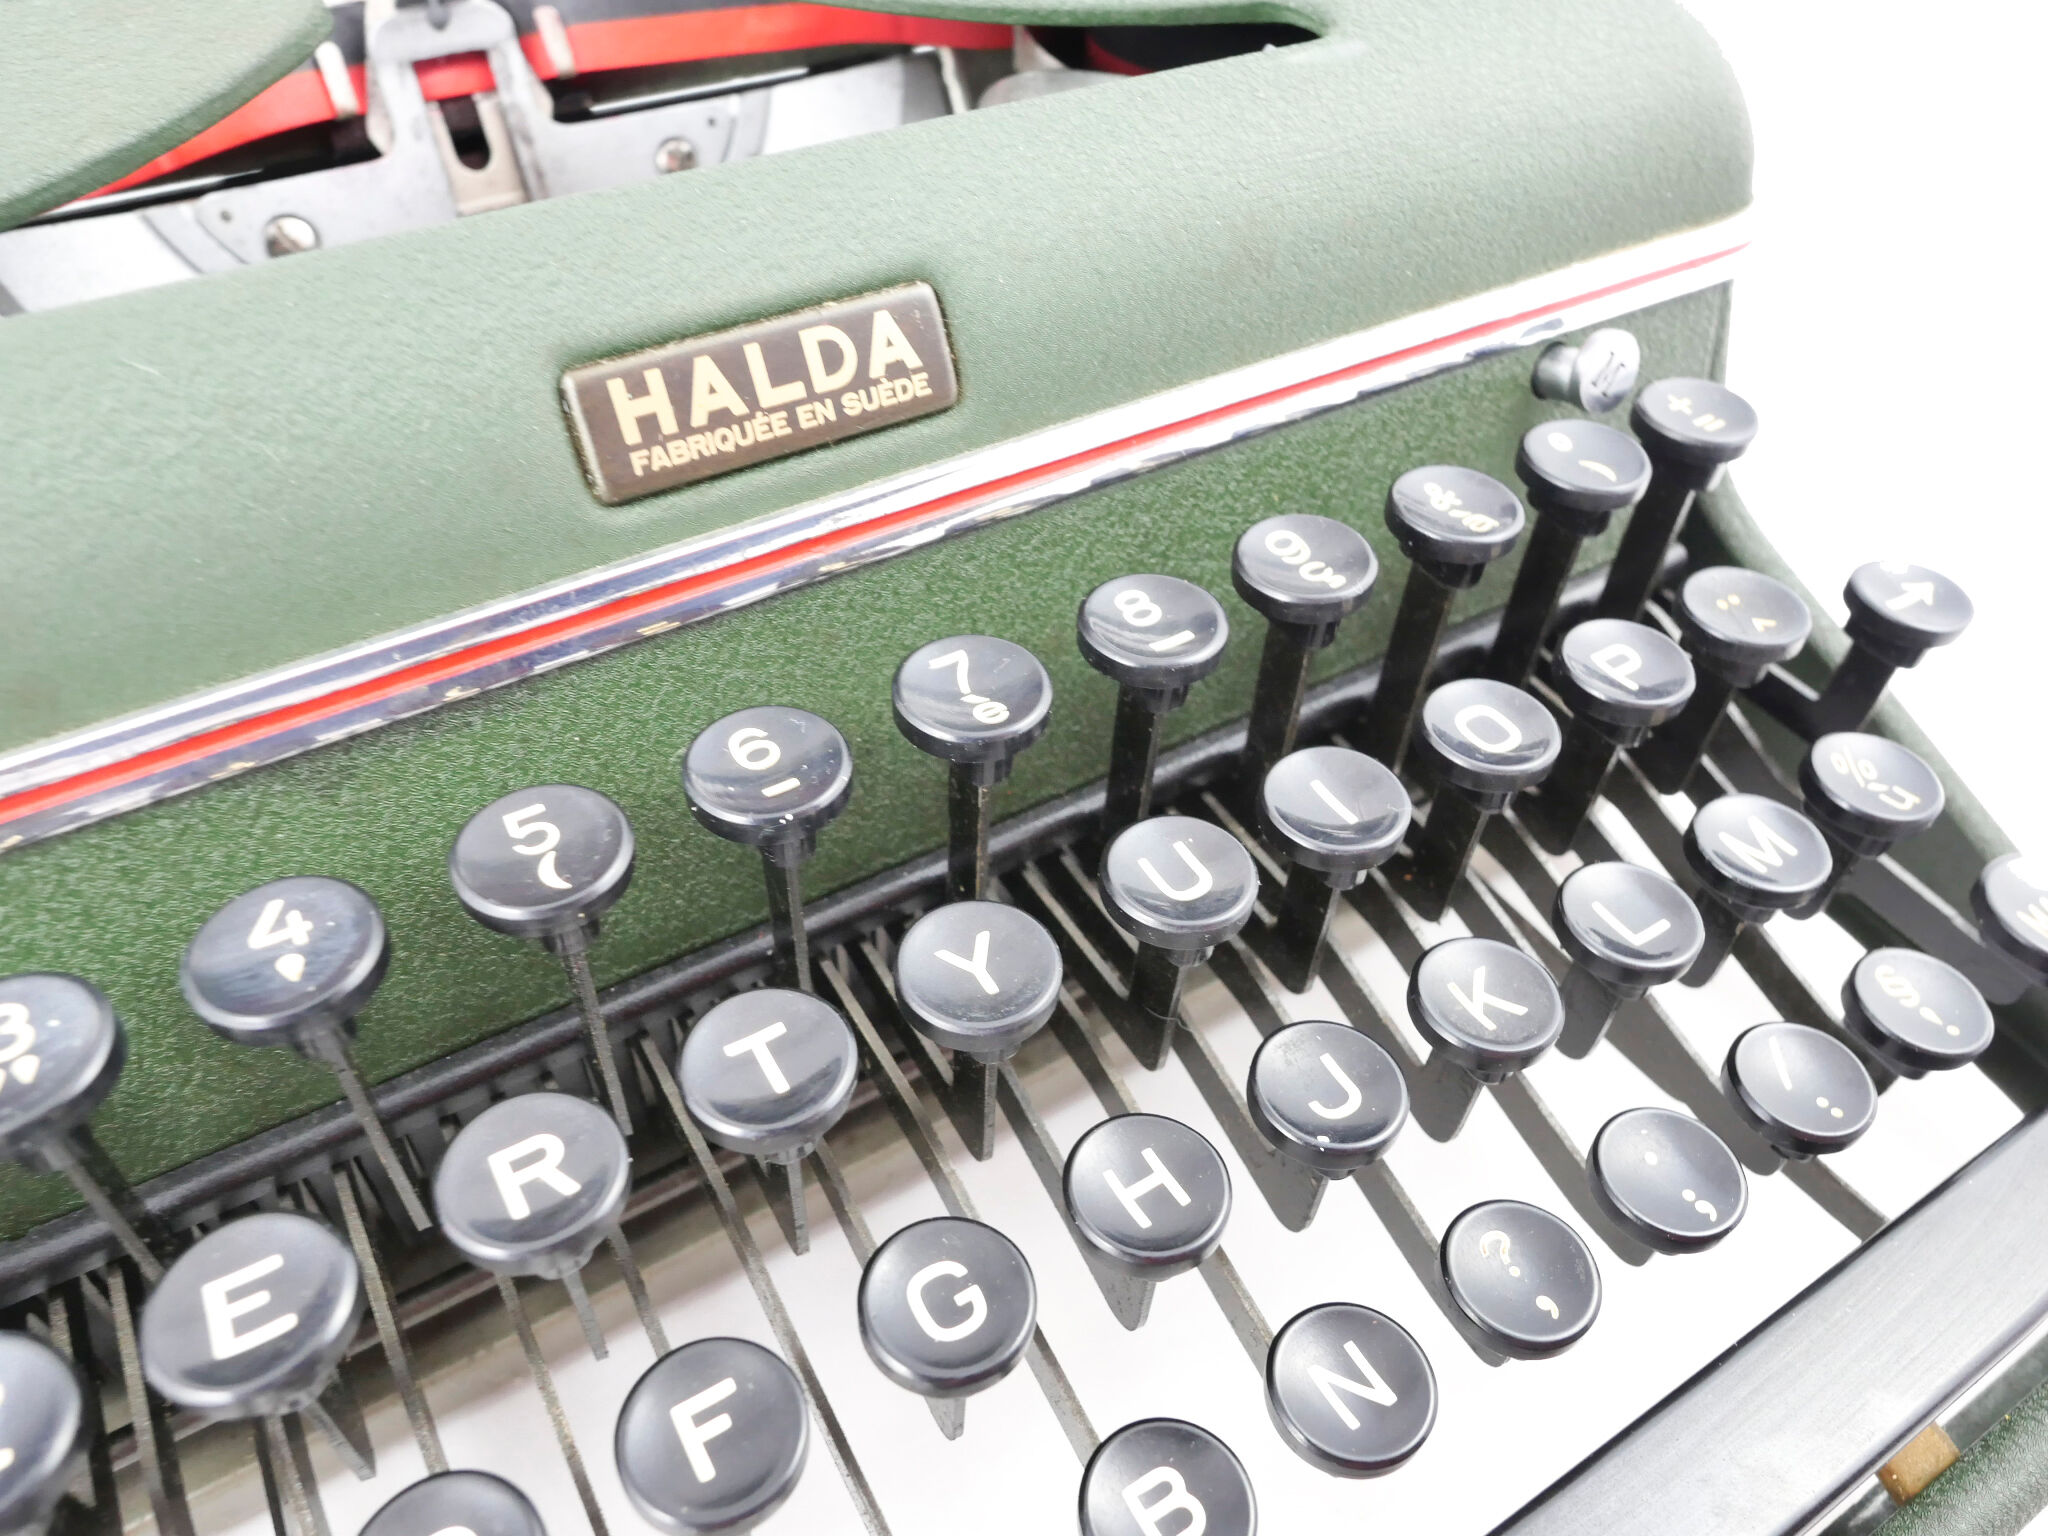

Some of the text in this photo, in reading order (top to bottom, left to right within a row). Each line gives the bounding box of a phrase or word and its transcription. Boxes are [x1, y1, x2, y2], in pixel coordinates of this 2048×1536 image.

[605, 309, 923, 446] HALDA
[628, 371, 933, 477] FABRIQUÉE EN SUÈDE
[1265, 530, 1311, 565] 9
[1114, 589, 1162, 627] 8
[928, 650, 971, 694] 7
[1589, 643, 1642, 690] P
[728, 727, 781, 770] 6
[1454, 703, 1522, 753] O
[502, 803, 560, 855] 5
[1309, 779, 1359, 824] I
[1137, 840, 1213, 901] U
[1714, 811, 1798, 874] M
[247, 899, 314, 949] 4
[1591, 900, 1671, 946] L
[933, 930, 1000, 995] Y
[1446, 965, 1529, 1031] K
[723, 1021, 790, 1094] T
[1308, 1052, 1362, 1119] J
[487, 1133, 581, 1220] R
[1101, 1147, 1192, 1229] H
[202, 1254, 297, 1359] E
[906, 1260, 988, 1342] G
[1304, 1340, 1398, 1430] N
[669, 1376, 737, 1484] F
[1121, 1466, 1207, 1536] B
